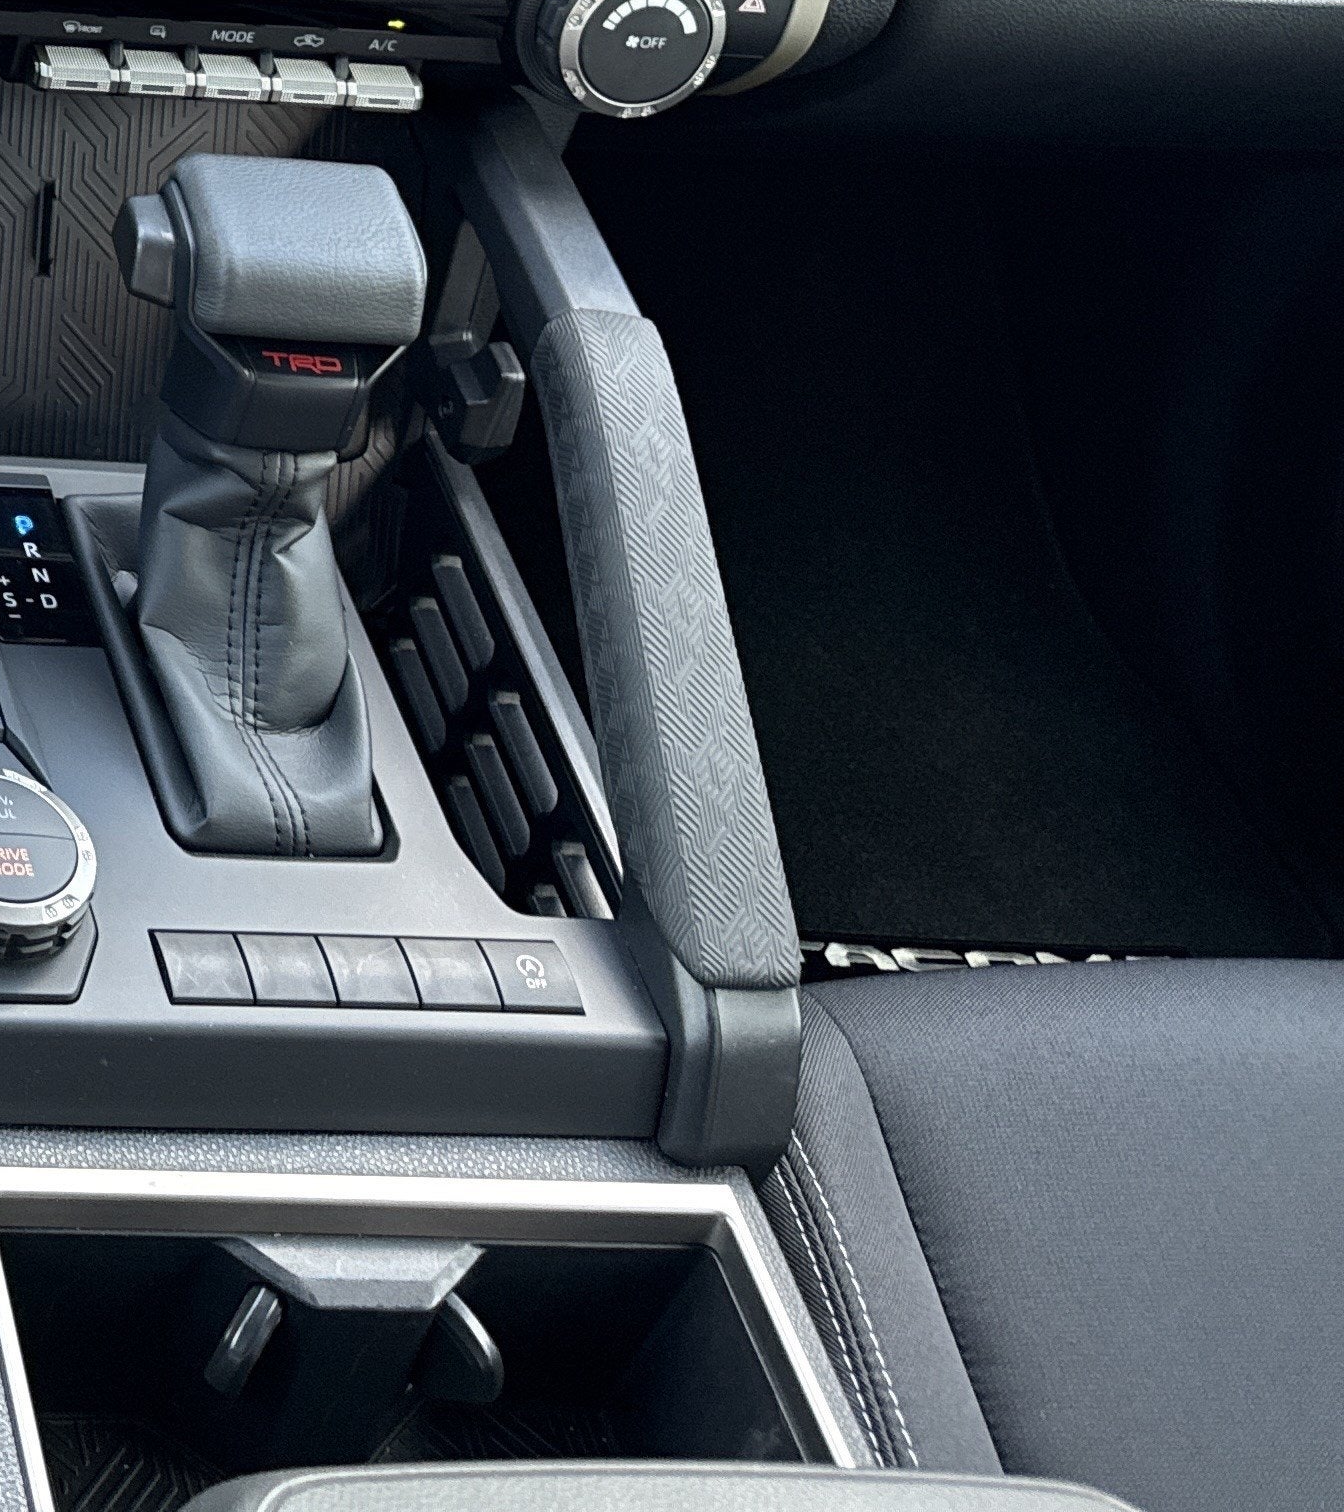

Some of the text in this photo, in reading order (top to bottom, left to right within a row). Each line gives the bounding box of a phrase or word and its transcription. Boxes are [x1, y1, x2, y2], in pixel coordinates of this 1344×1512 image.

[212, 29, 255, 44] MODE
[639, 36, 667, 49] OFF
[369, 39, 398, 52] A/C
[262, 349, 343, 375] TRD
[14, 515, 33, 535] P
[23, 542, 41, 558] R
[31, 567, 51, 583] N
[3, 592, 58, 609] S D
[526, 977, 547, 989] OFF
